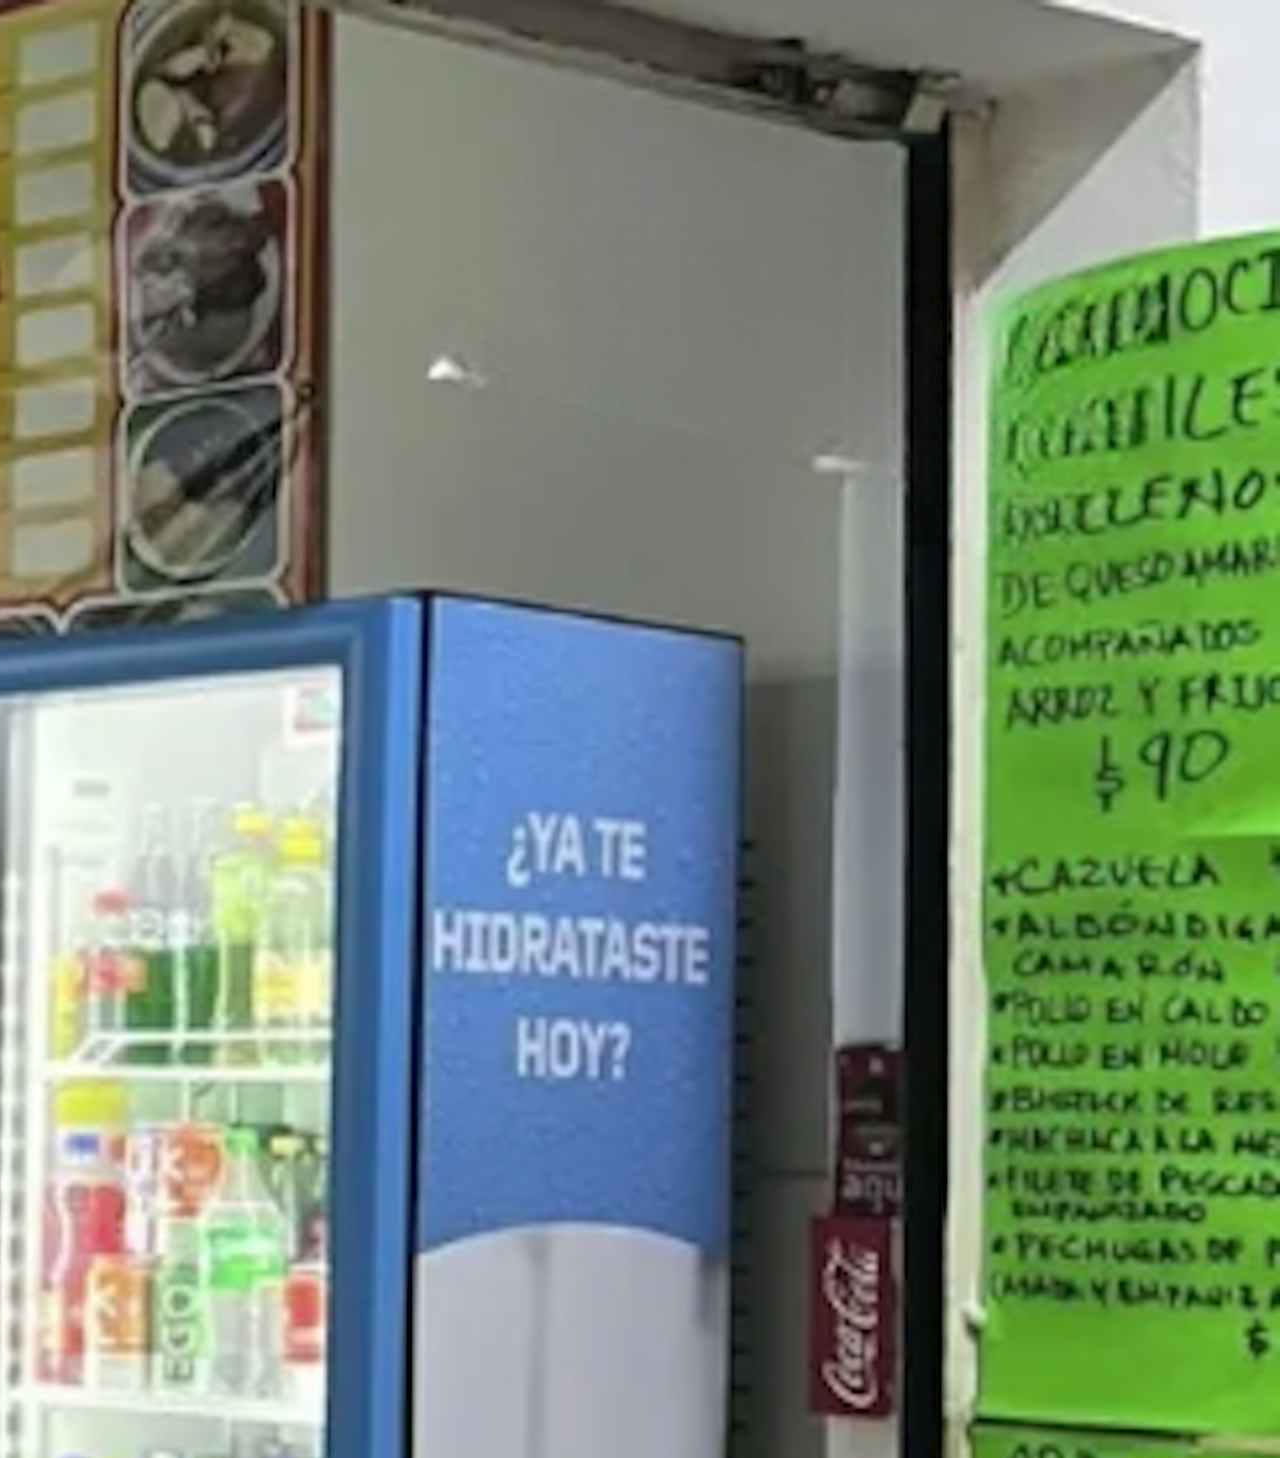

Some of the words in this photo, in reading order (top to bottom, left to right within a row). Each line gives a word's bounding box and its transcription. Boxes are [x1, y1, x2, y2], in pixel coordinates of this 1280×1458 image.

[1000, 572, 1056, 620] DE
[1138, 675, 1163, 717] Y
[506, 811, 587, 888] ¿YA
[592, 816, 646, 881] TE
[432, 907, 710, 985] HIDRATASTE
[1105, 996, 1142, 1024] EN
[515, 1015, 631, 1081] HOY?
[1101, 1044, 1142, 1071] EN
